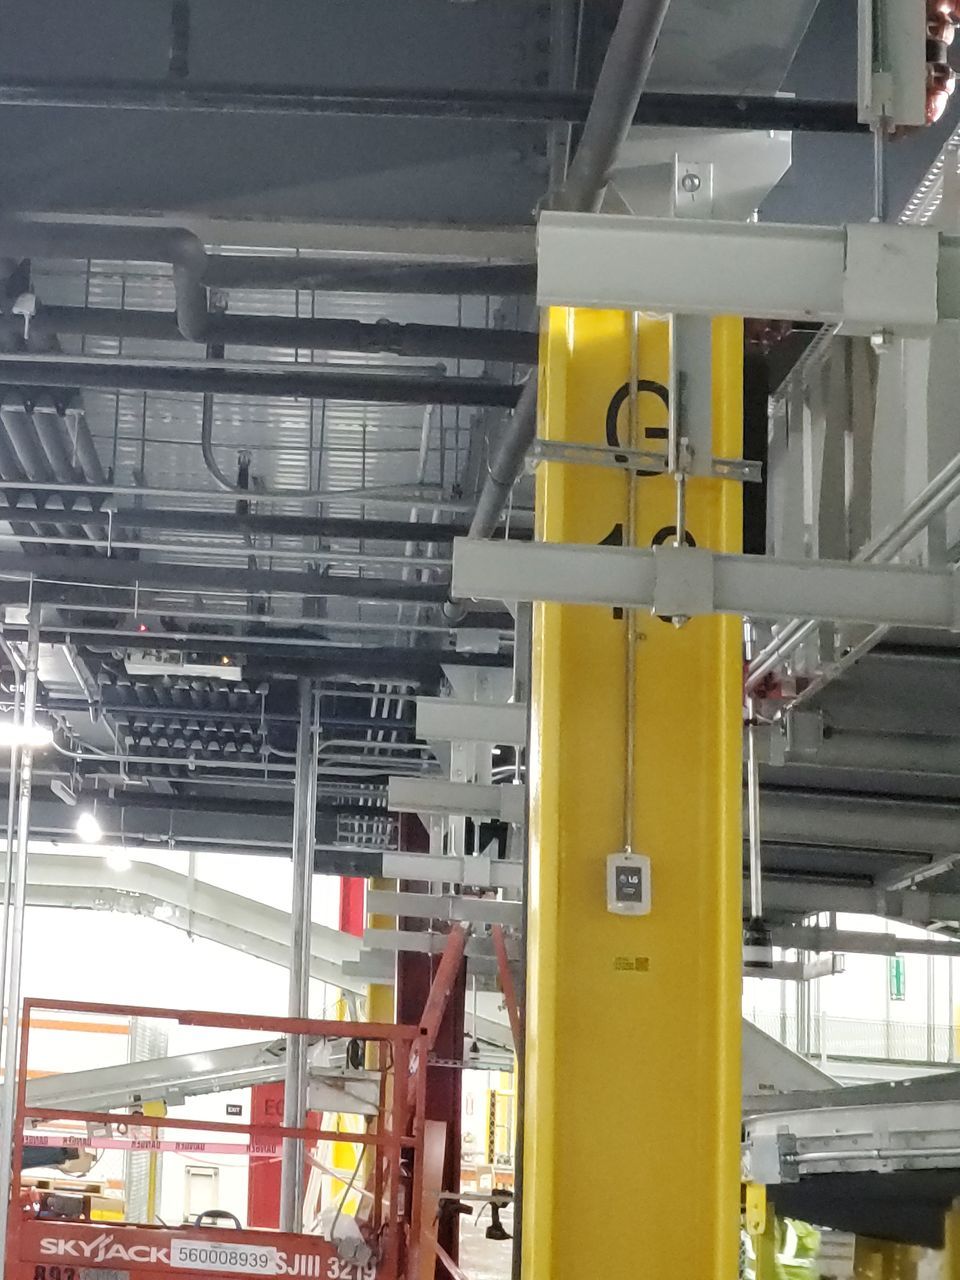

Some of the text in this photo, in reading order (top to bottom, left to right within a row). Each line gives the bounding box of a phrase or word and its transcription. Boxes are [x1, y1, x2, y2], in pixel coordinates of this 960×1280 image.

[628, 875, 639, 884] LG
[227, 1106, 241, 1114] EXIT
[40, 1233, 171, 1264] SKYJACK
[178, 1247, 269, 1269] 560008939
